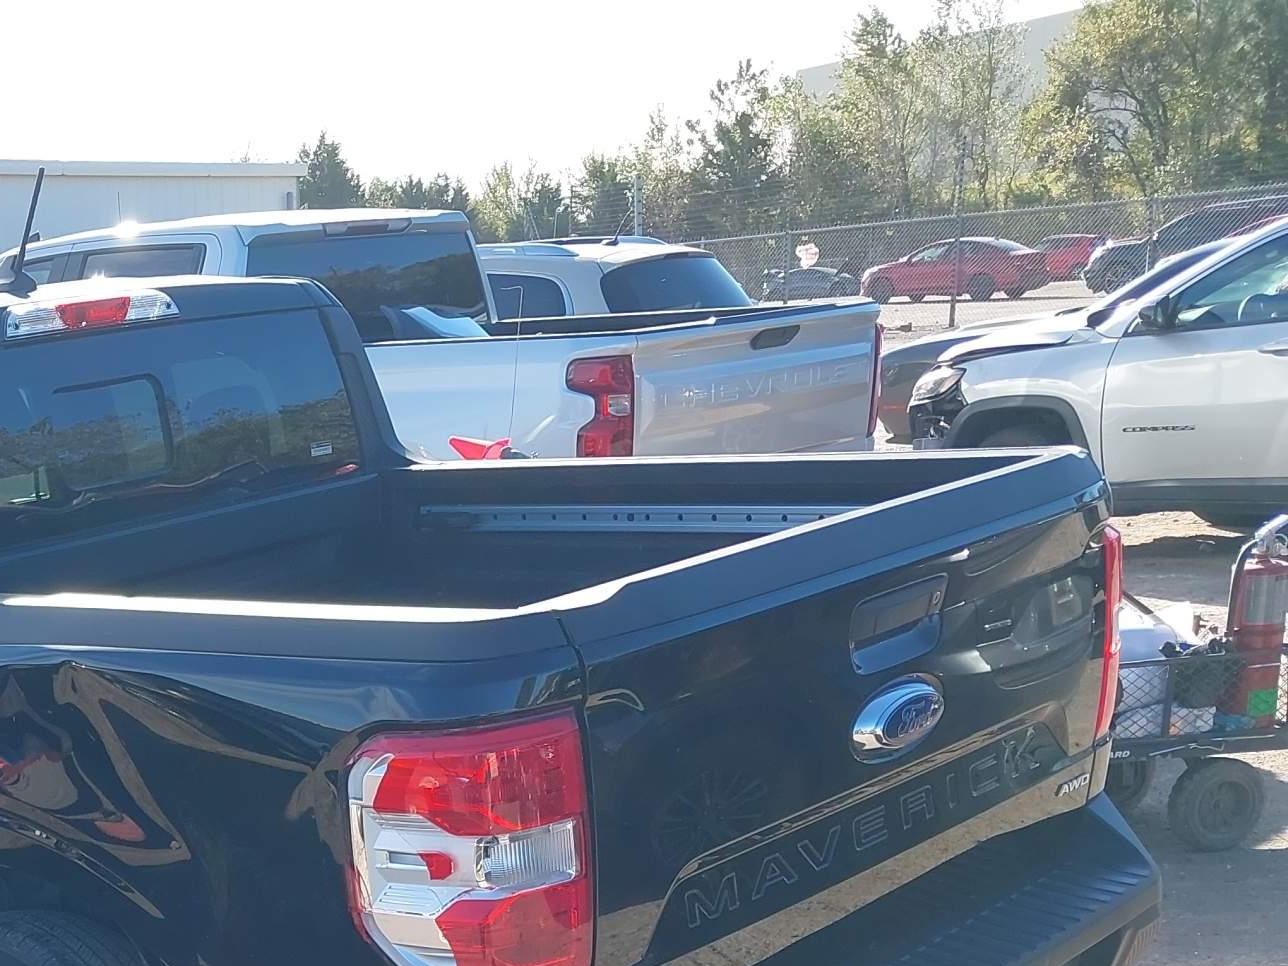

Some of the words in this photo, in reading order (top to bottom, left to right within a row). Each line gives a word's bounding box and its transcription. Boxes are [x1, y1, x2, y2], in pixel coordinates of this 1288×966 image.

[1121, 425, 1197, 433] COMPASS
[1056, 773, 1090, 798] AWD
[683, 727, 1040, 927] MAVERICK
